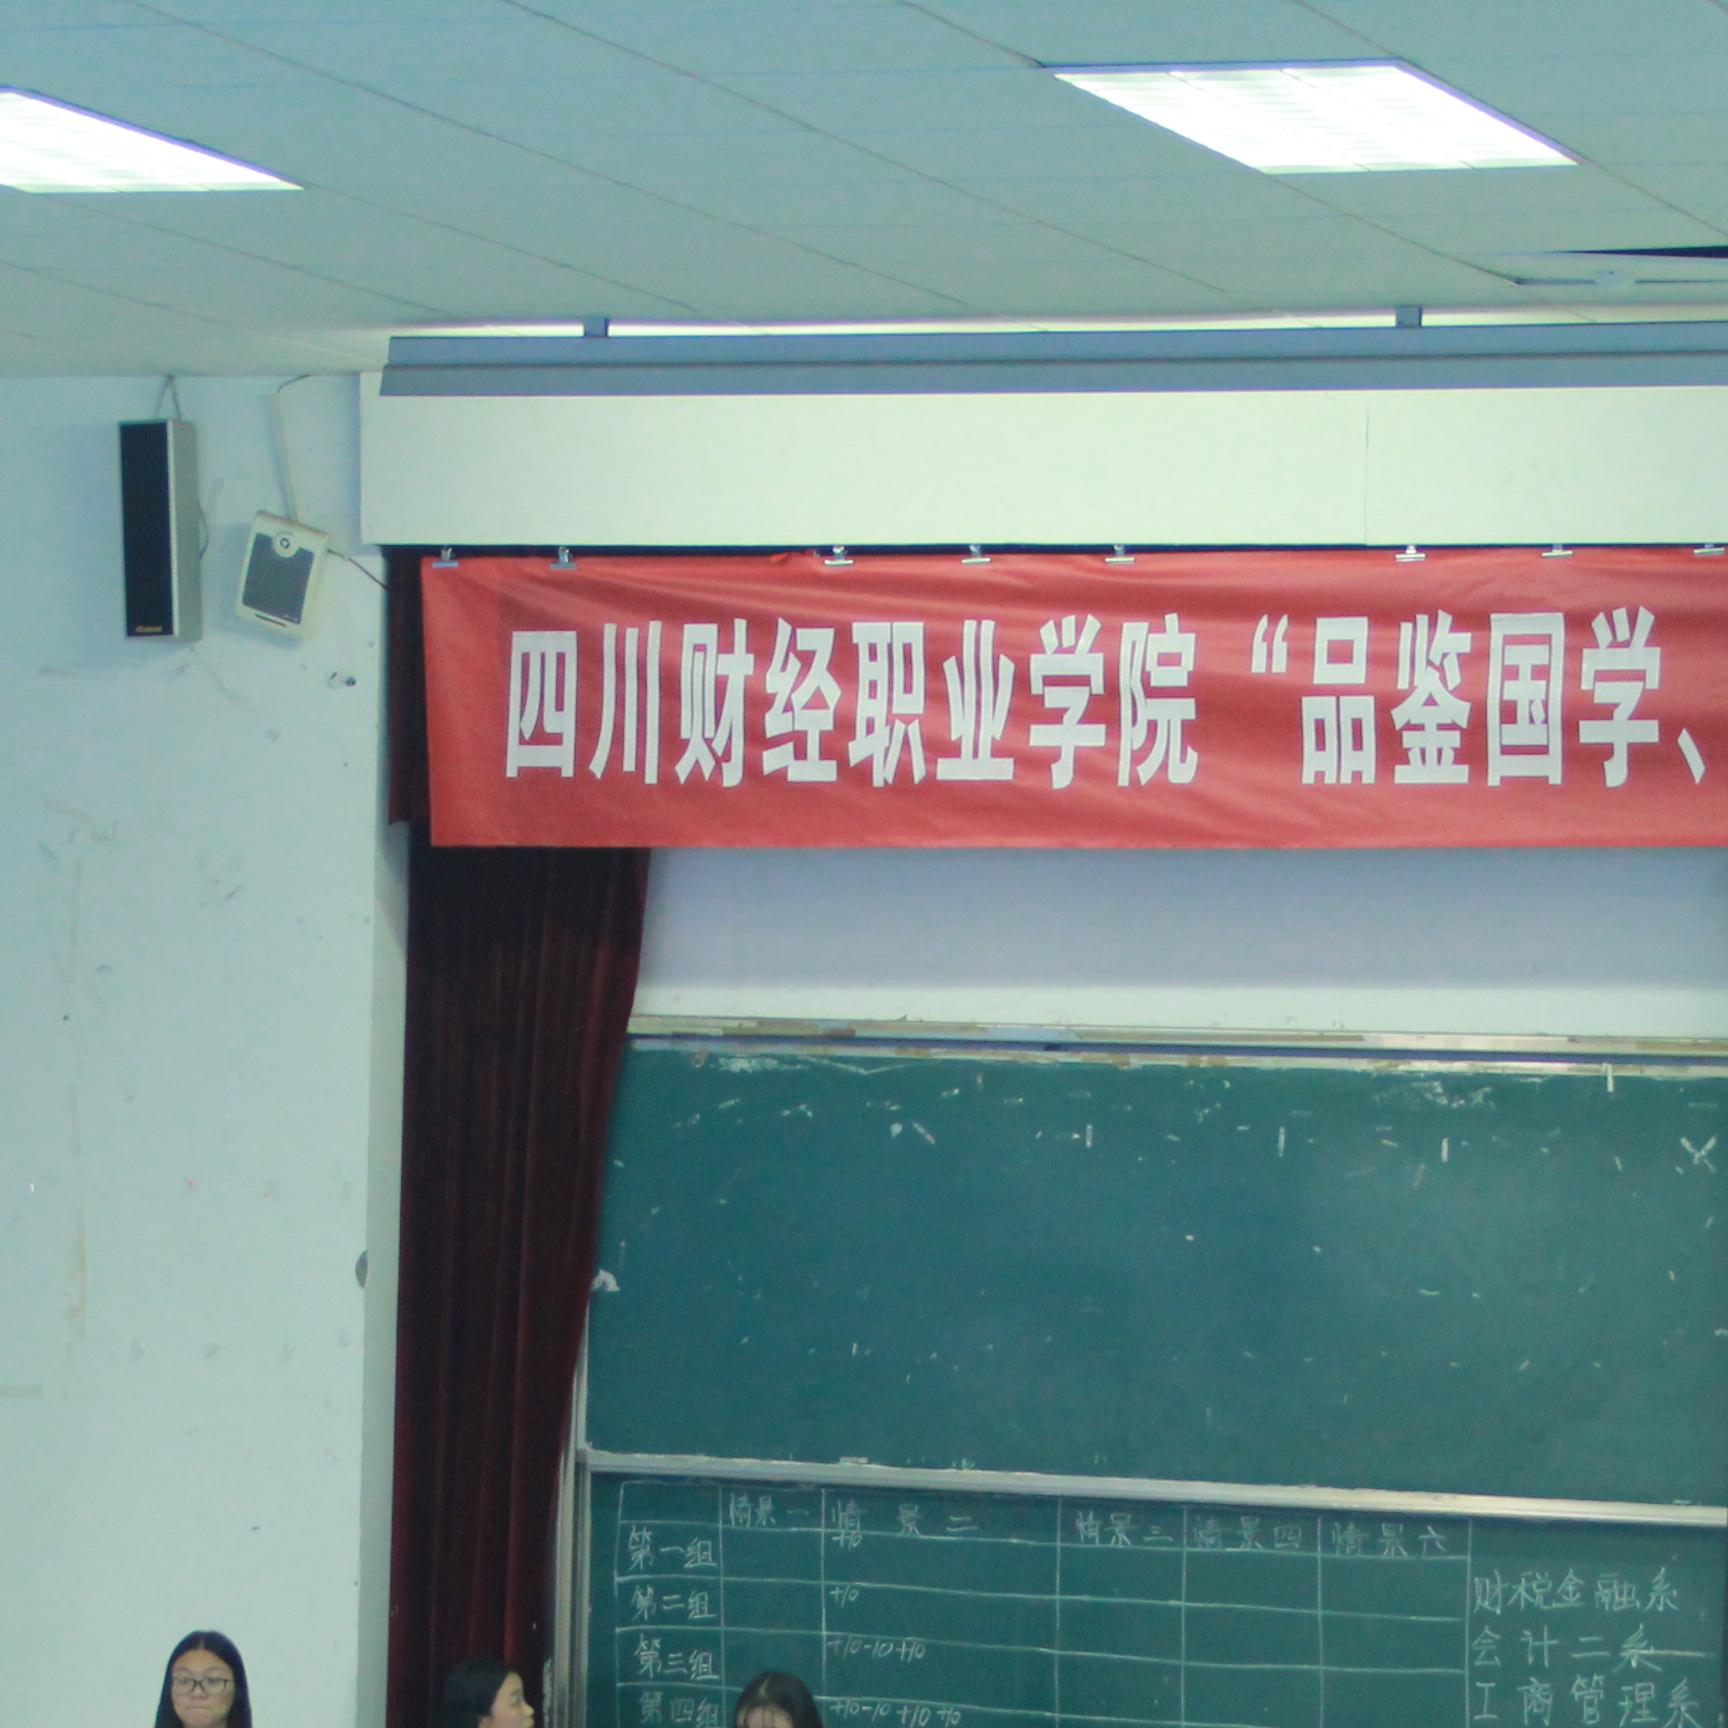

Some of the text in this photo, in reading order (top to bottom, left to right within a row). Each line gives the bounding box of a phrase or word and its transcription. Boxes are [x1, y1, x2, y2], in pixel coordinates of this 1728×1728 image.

[627, 1525, 718, 1569] 第一组
[631, 1584, 718, 1620] 第二组
[1472, 1566, 1678, 1615] 财税金融系
[634, 1633, 720, 1680] 第三组
